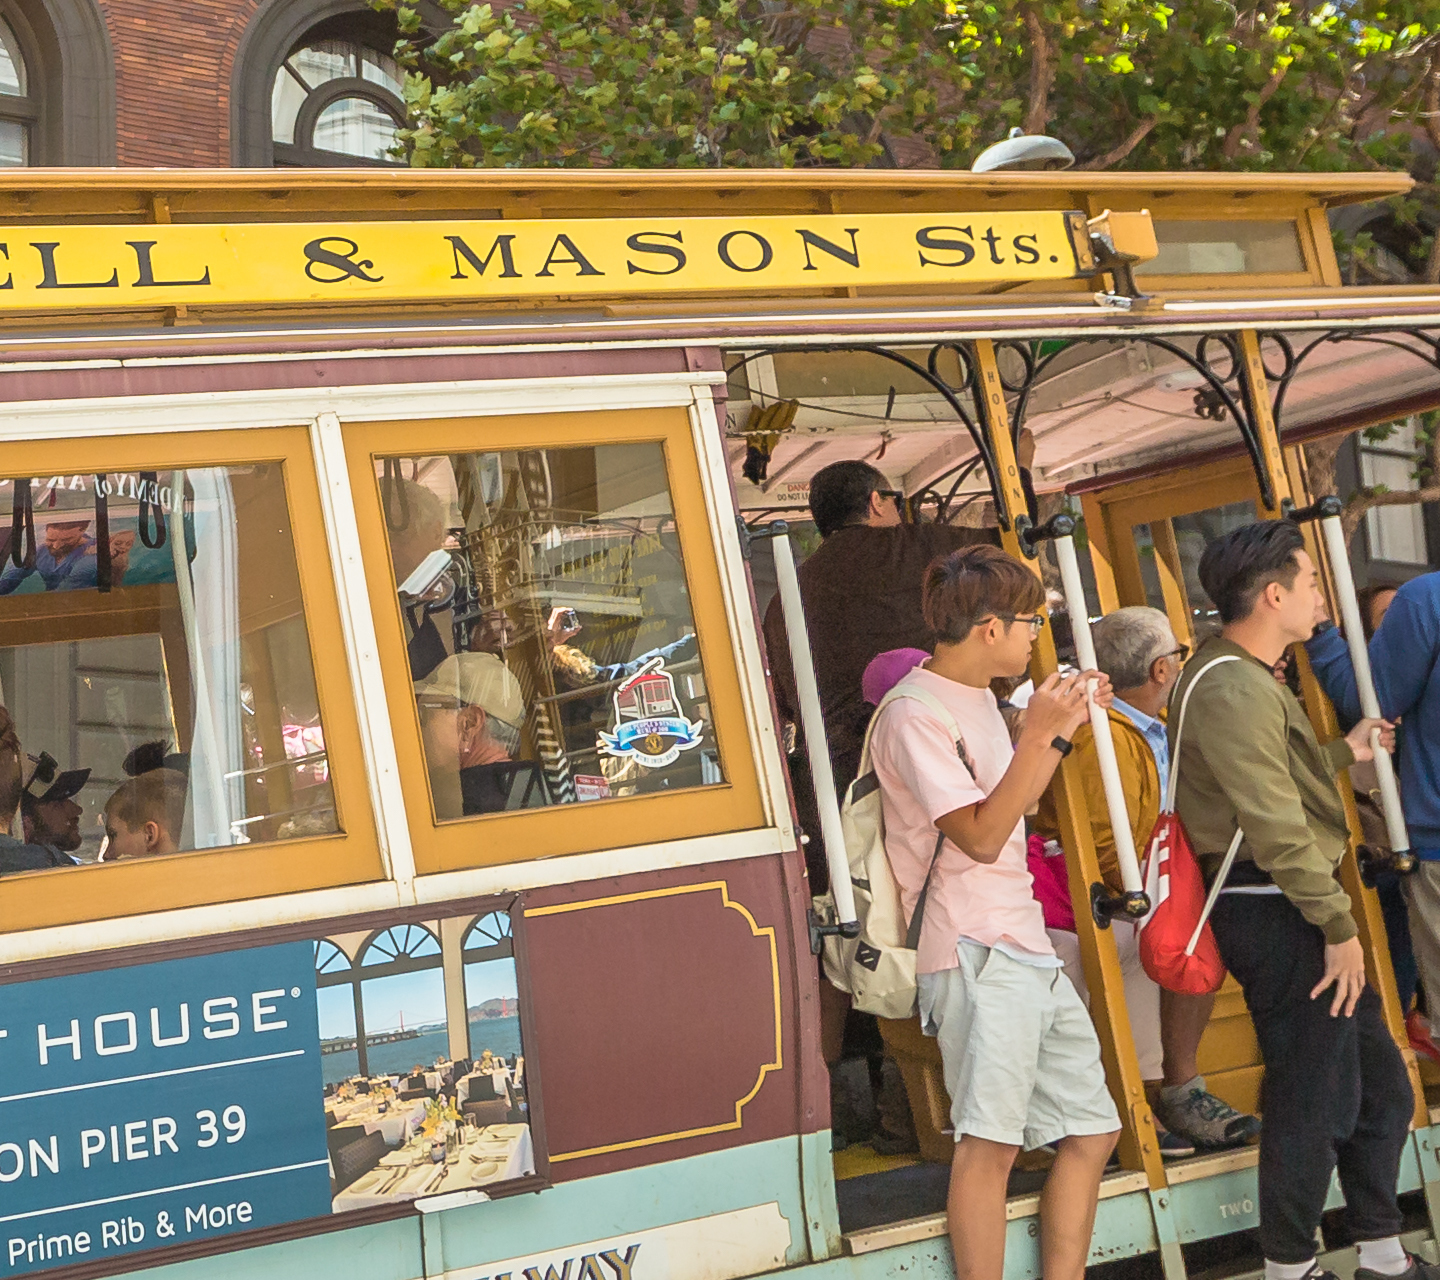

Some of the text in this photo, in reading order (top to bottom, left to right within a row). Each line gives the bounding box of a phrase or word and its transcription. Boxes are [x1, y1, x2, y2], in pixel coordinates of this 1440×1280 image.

[302, 235, 385, 283] &
[443, 227, 862, 280] MASON
[915, 221, 1061, 268] Sts.
[1007, 464, 1023, 500] ON
[80, 1116, 180, 1169] PIER
[195, 1104, 247, 1149] 39
[8, 1230, 92, 1267] Prime
[100, 1215, 146, 1250] Rib
[156, 1209, 178, 1239] &
[184, 1200, 255, 1234] More
[1220, 1198, 1254, 1219] TWO
